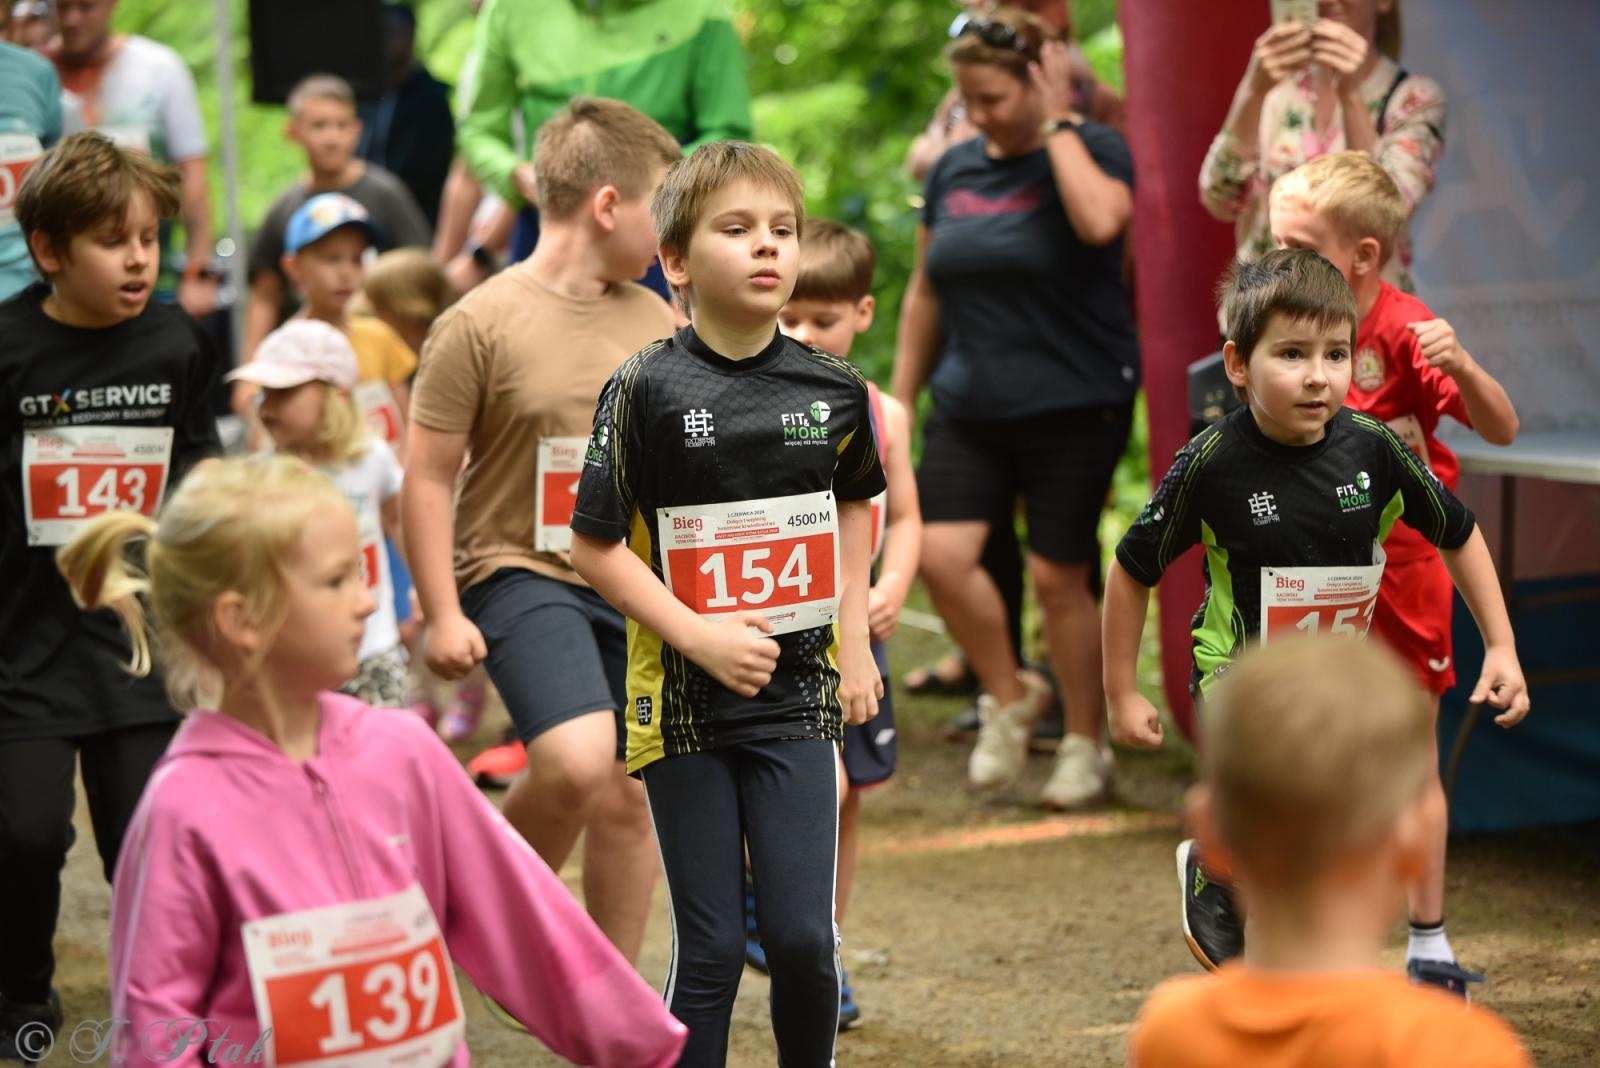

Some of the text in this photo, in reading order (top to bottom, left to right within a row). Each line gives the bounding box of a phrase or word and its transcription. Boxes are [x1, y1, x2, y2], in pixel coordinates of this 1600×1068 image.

[20, 383, 172, 417] GTX SERVICE
[783, 426, 828, 440] MORE
[55, 466, 147, 516] 143
[1340, 492, 1371, 508] MORE
[673, 516, 704, 532] Bieg
[787, 510, 831, 527] 4500 M
[699, 543, 813, 608] 154
[1275, 576, 1305, 591] Bieg
[309, 950, 440, 1054] 139
